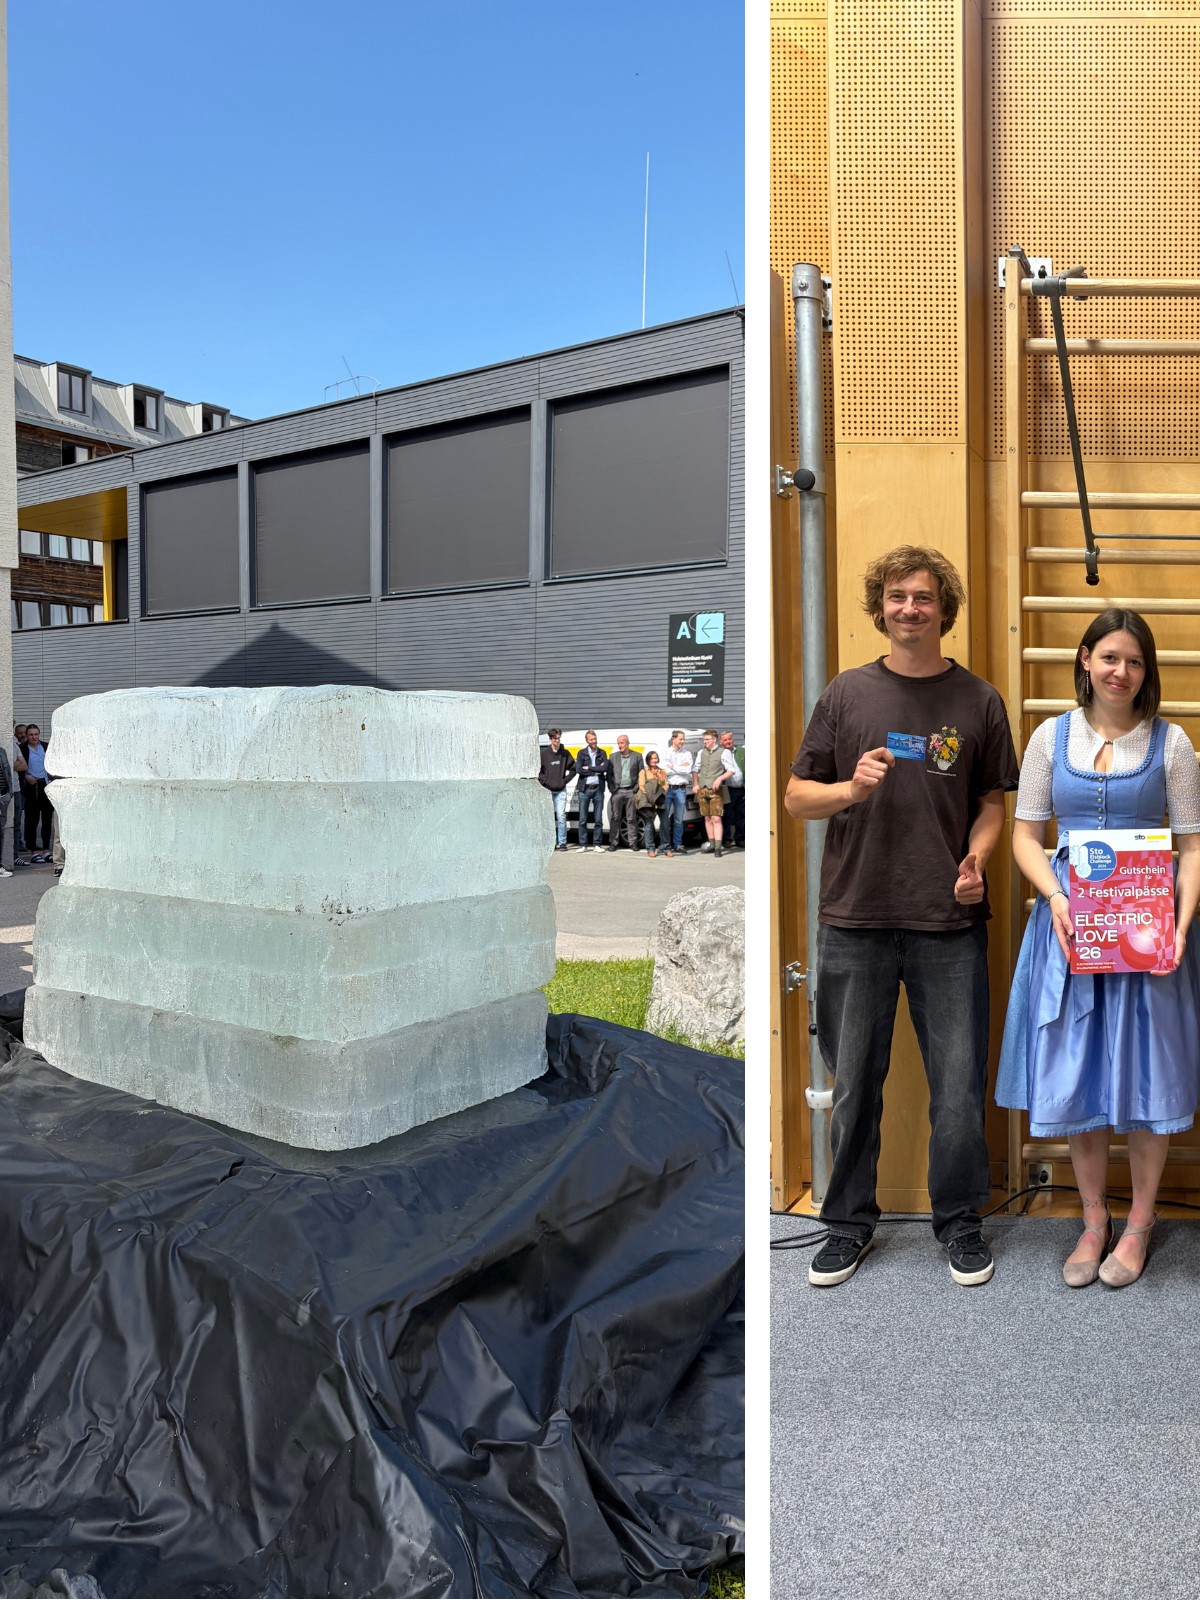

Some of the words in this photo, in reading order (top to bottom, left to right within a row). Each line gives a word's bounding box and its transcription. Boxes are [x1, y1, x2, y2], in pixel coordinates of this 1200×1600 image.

[676, 621, 691, 639] A
[1119, 866, 1166, 875] Gutschein
[1077, 887, 1085, 898] 2
[1089, 886, 1170, 899] Festivalpässe
[1075, 912, 1154, 926] ELECTRIC
[1075, 930, 1118, 943] LOVE
